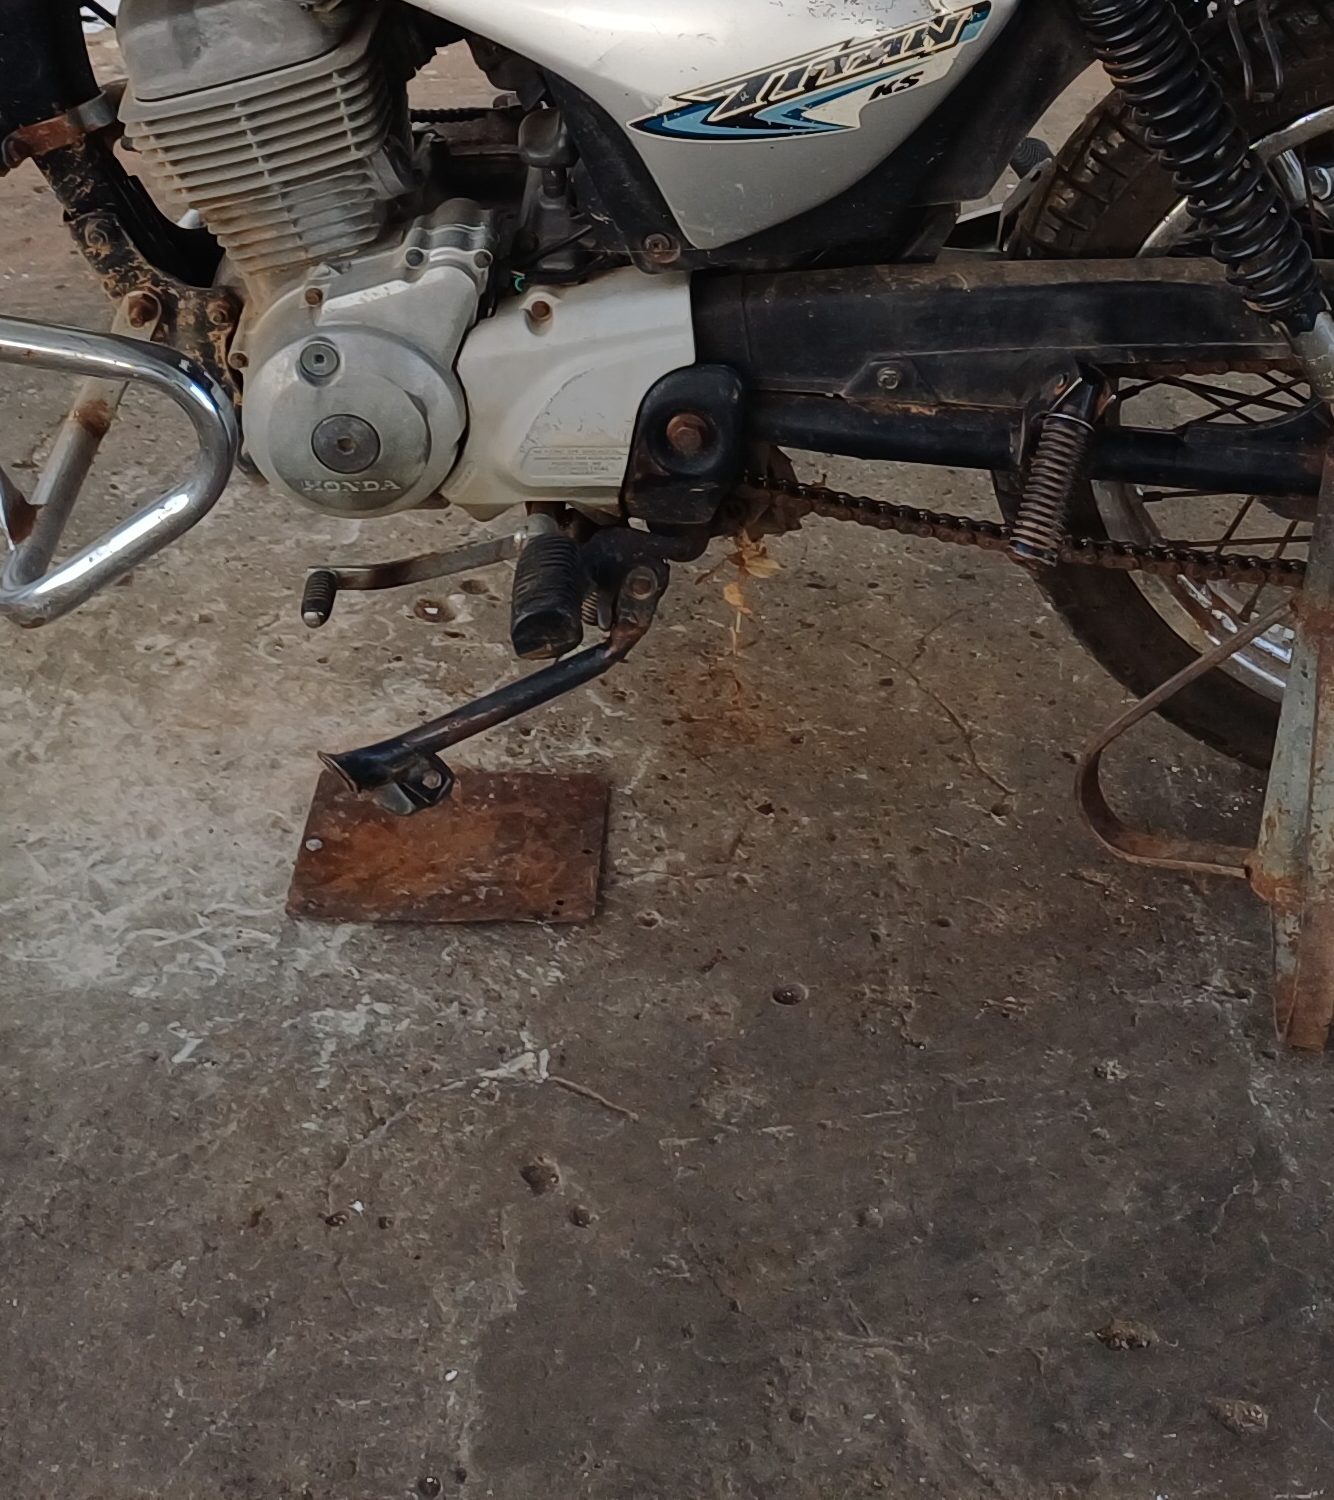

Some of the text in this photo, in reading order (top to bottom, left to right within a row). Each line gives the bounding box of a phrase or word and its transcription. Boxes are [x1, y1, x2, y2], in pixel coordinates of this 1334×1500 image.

[671, 6, 975, 120] TITAN
[867, 70, 925, 102] KS
[302, 479, 402, 493] HONDA
